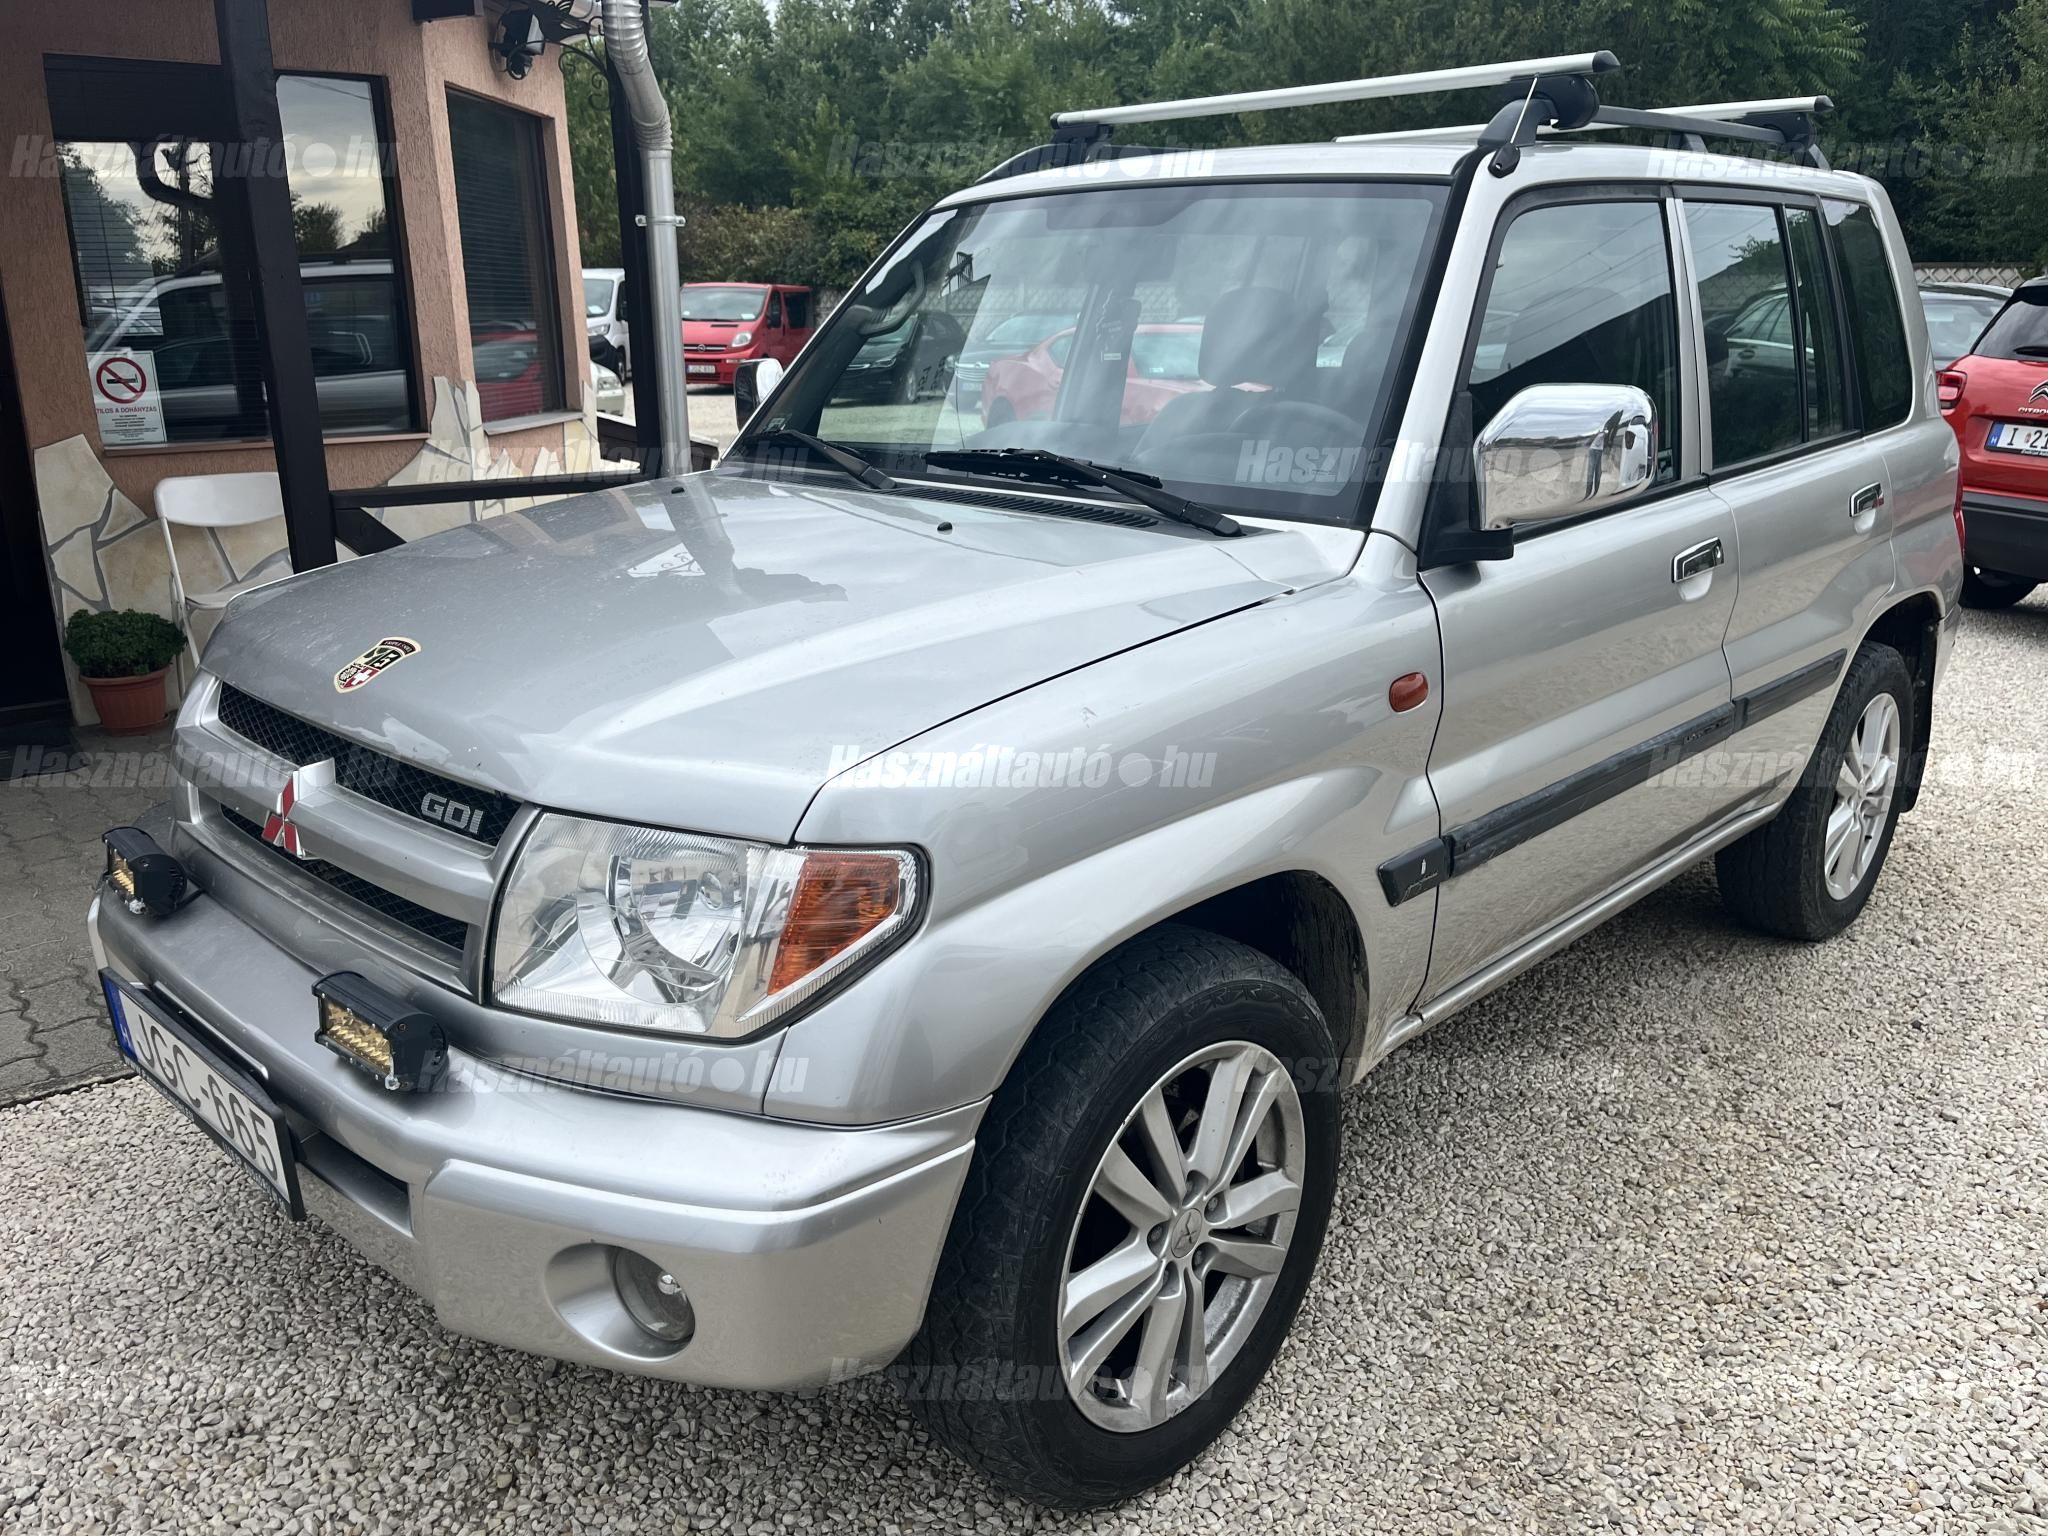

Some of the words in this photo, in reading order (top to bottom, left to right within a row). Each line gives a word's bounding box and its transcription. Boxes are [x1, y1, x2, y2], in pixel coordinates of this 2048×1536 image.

[2018, 406, 2048, 415] CITRO
[421, 792, 483, 834] GDI
[136, 1014, 277, 1181] JGC-665
